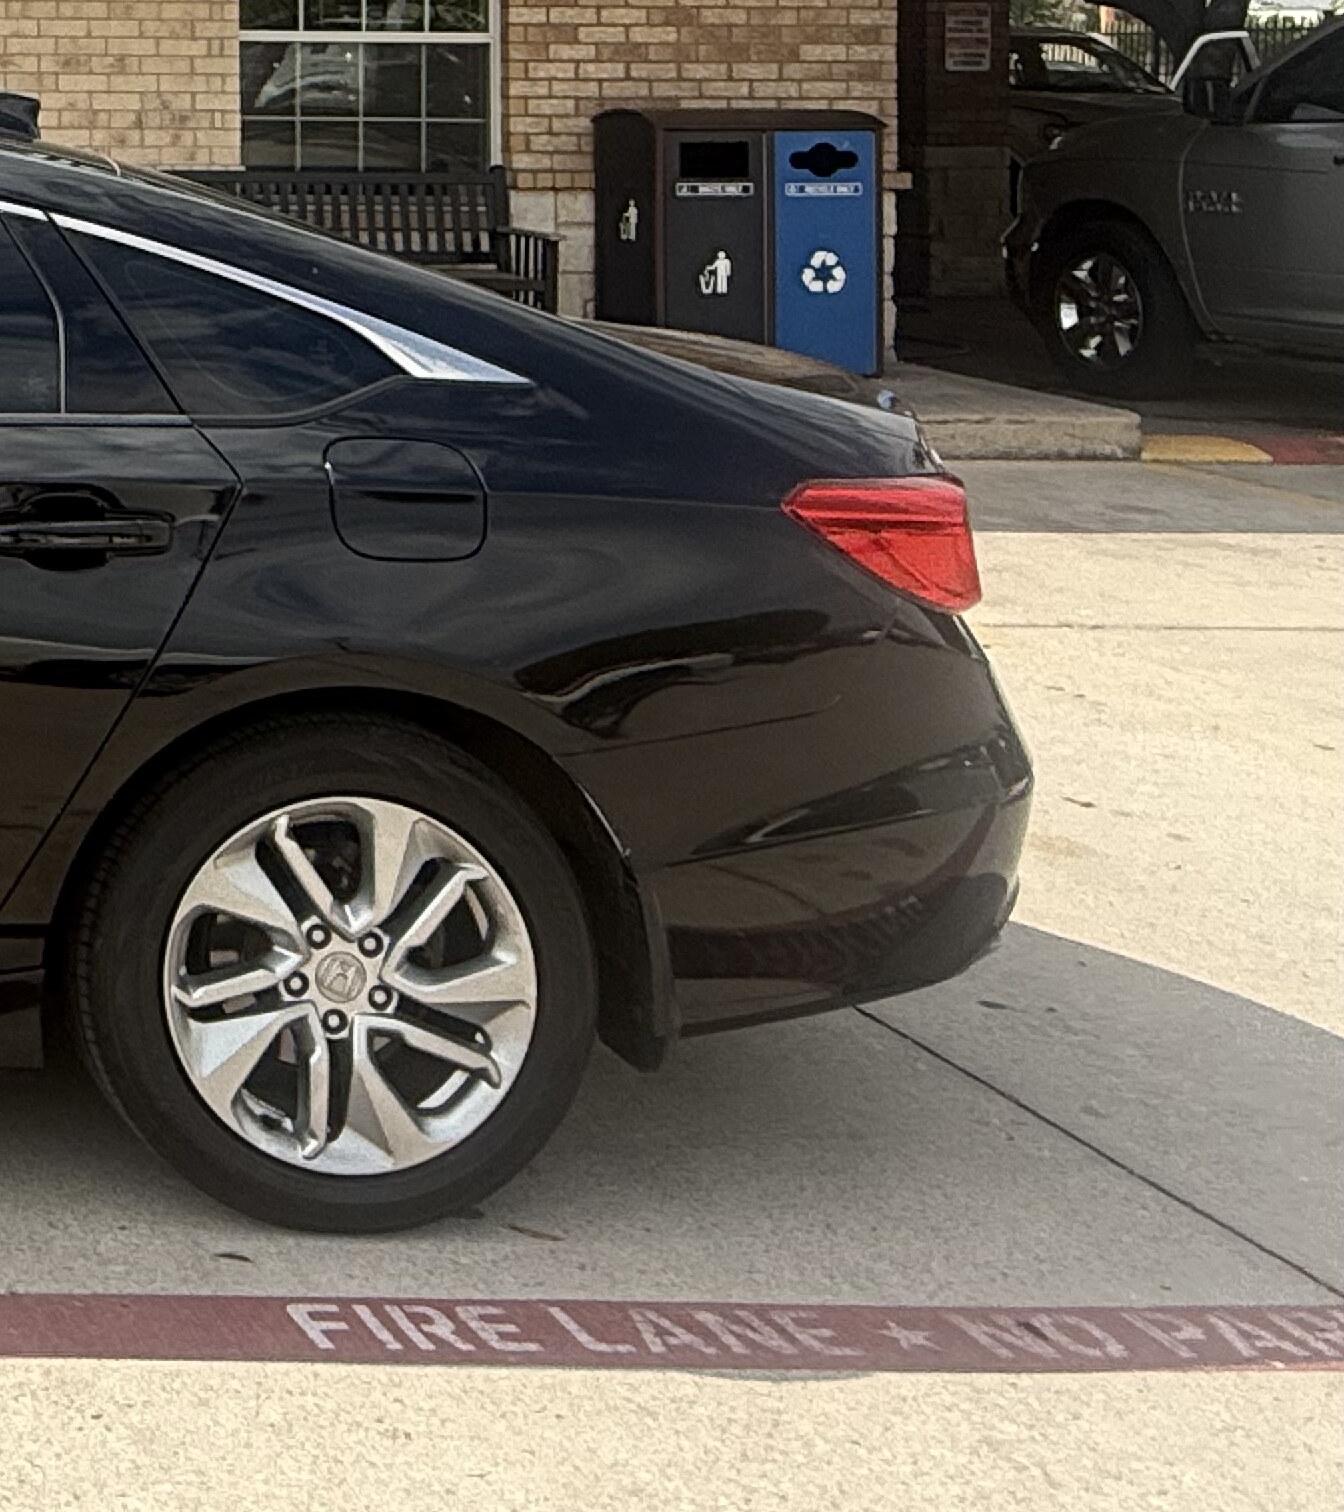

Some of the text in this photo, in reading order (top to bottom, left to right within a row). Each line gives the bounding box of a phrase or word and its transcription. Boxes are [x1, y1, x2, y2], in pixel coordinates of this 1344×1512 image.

[286, 1303, 1344, 1359] FIRE LANE NO PAR
